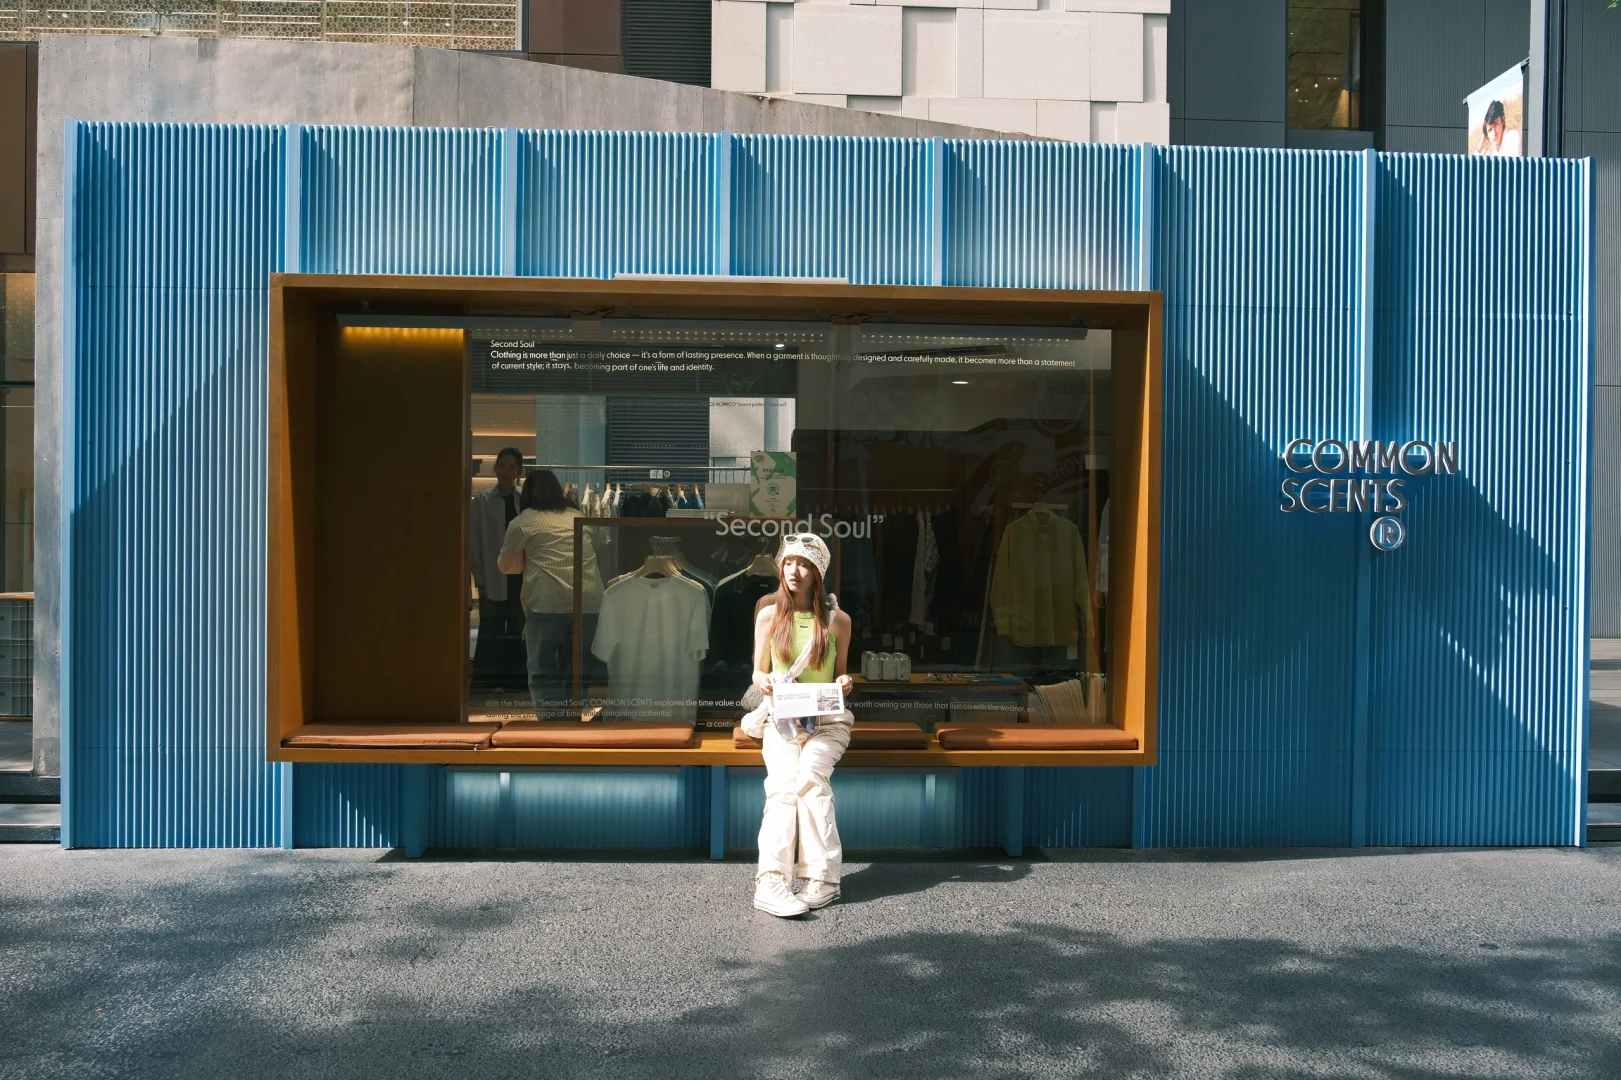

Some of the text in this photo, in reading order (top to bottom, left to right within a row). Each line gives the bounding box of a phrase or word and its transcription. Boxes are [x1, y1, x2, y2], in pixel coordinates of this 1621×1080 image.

[490, 340, 535, 348] Second Soul
[490, 350, 521, 360] Clothing
[522, 351, 529, 359] is
[550, 351, 566, 359] than
[566, 351, 579, 361] just
[587, 351, 605, 361] daily
[606, 351, 631, 359] choice
[659, 351, 675, 359] form
[676, 351, 684, 359] of
[685, 351, 710, 361] lasting
[711, 352, 746, 361] presence.
[747, 351, 765, 359] When
[773, 352, 803, 361] garment
[804, 352, 810, 360] is
[811, 352, 852, 363] thoughtfully
[853, 354, 886, 363] designed
[904, 355, 934, 364] carefully
[935, 356, 957, 364] made,
[958, 356, 963, 364] it
[965, 356, 997, 364] becomes
[1017, 357, 1033, 365] than
[1041, 359, 1076, 367] statement
[492, 362, 500, 370] of
[500, 362, 525, 370] current
[526, 362, 545, 371] style;
[545, 362, 551, 370] it
[574, 362, 611, 372] becoming
[612, 363, 628, 372] part
[629, 363, 637, 371] of
[638, 363, 657, 371] one's
[657, 363, 669, 371] life
[670, 363, 685, 371] and
[686, 363, 714, 372] identity.
[1284, 438, 1457, 475] COMMON
[1280, 478, 1407, 513] SCENTS
[627, 699, 653, 707] SCENTS
[654, 699, 684, 708] explores
[686, 699, 697, 707] the
[699, 699, 714, 707] time
[714, 699, 734, 707] value
[854, 700, 873, 708] worth
[874, 701, 899, 710] owning
[914, 701, 933, 709] those
[934, 701, 949, 709] that
[950, 702, 962, 710] live
[987, 703, 1000, 711] the
[557, 709, 565, 717] of
[566, 709, 582, 717] time
[602, 709, 637, 718] remaining
